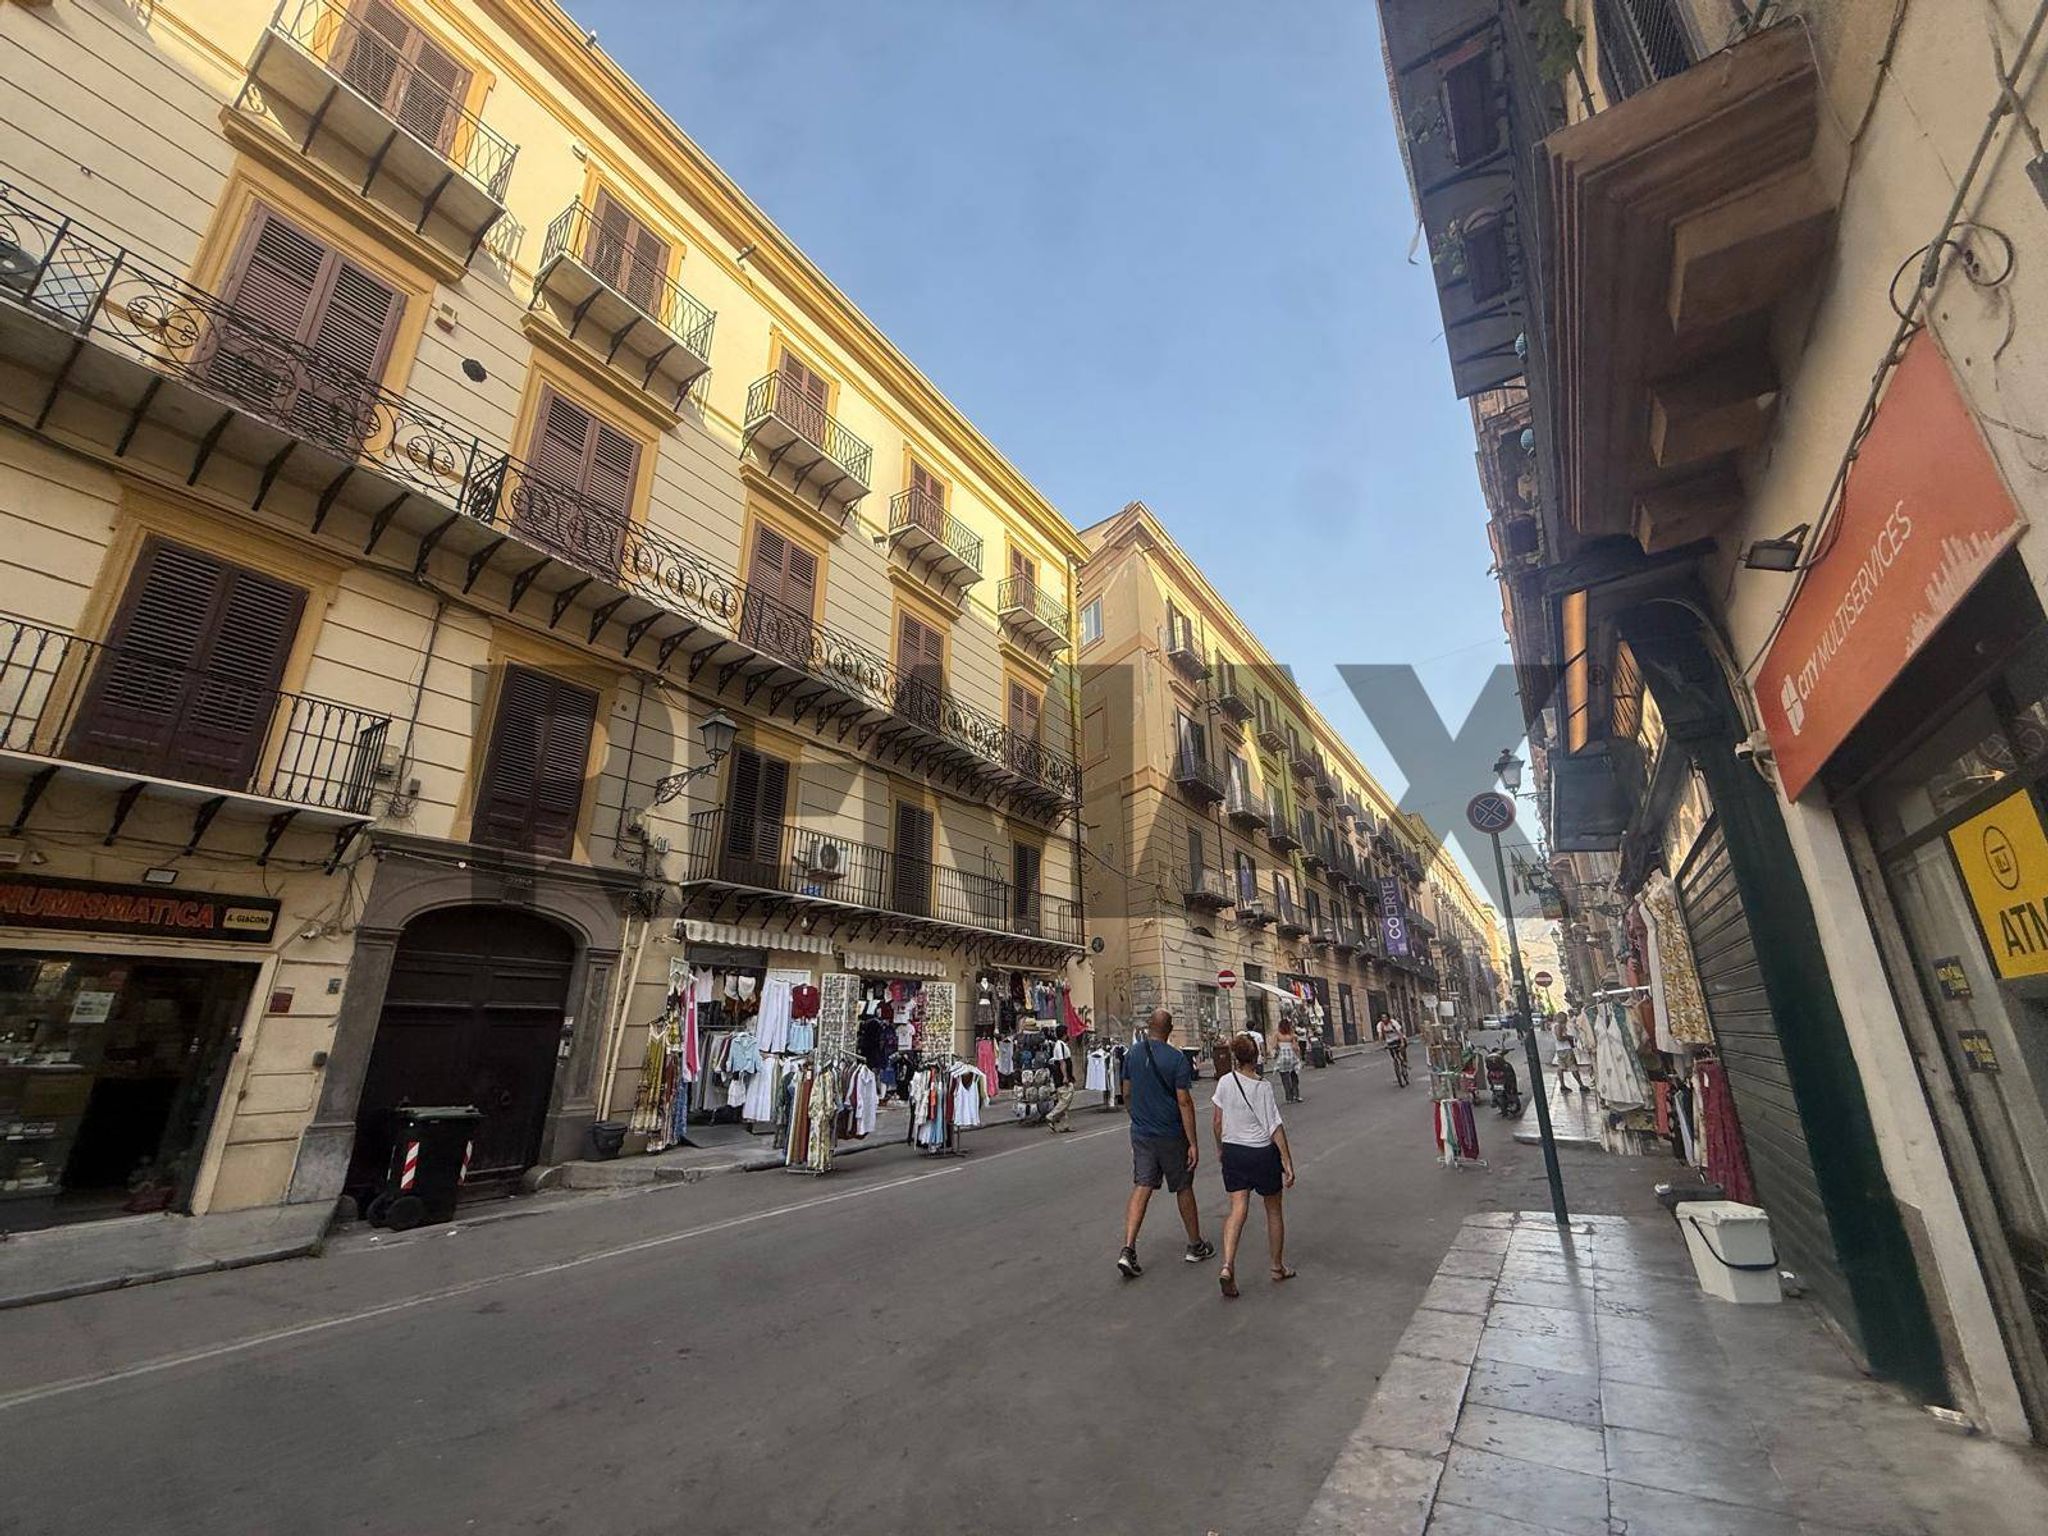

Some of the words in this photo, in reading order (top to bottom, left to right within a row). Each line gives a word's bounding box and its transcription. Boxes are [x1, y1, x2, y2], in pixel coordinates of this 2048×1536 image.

[1797, 652, 1820, 701] CITY
[1816, 499, 1912, 670] MULTISERVICES
[0, 884, 214, 928] NUMISMATICA
[1999, 896, 2048, 957] ATM
